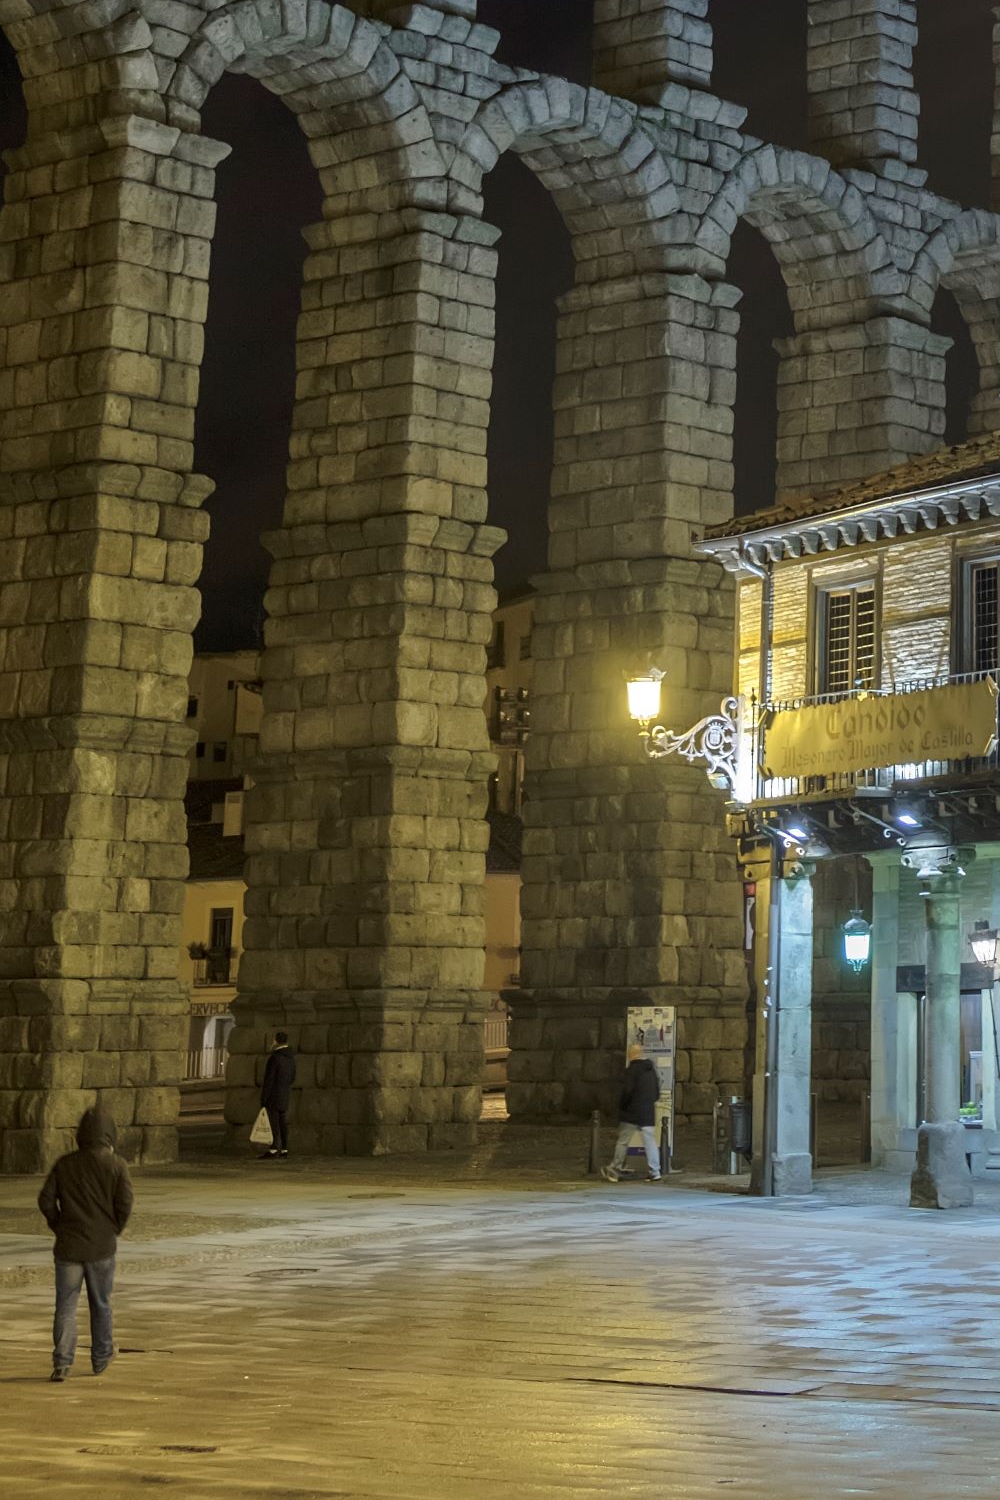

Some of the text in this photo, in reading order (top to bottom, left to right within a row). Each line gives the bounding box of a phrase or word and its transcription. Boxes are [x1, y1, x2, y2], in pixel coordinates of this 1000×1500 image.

[826, 704, 926, 740] Candido
[781, 744, 845, 769] Mesonero
[847, 739, 892, 765] Mayor
[920, 725, 973, 751] Castilla
